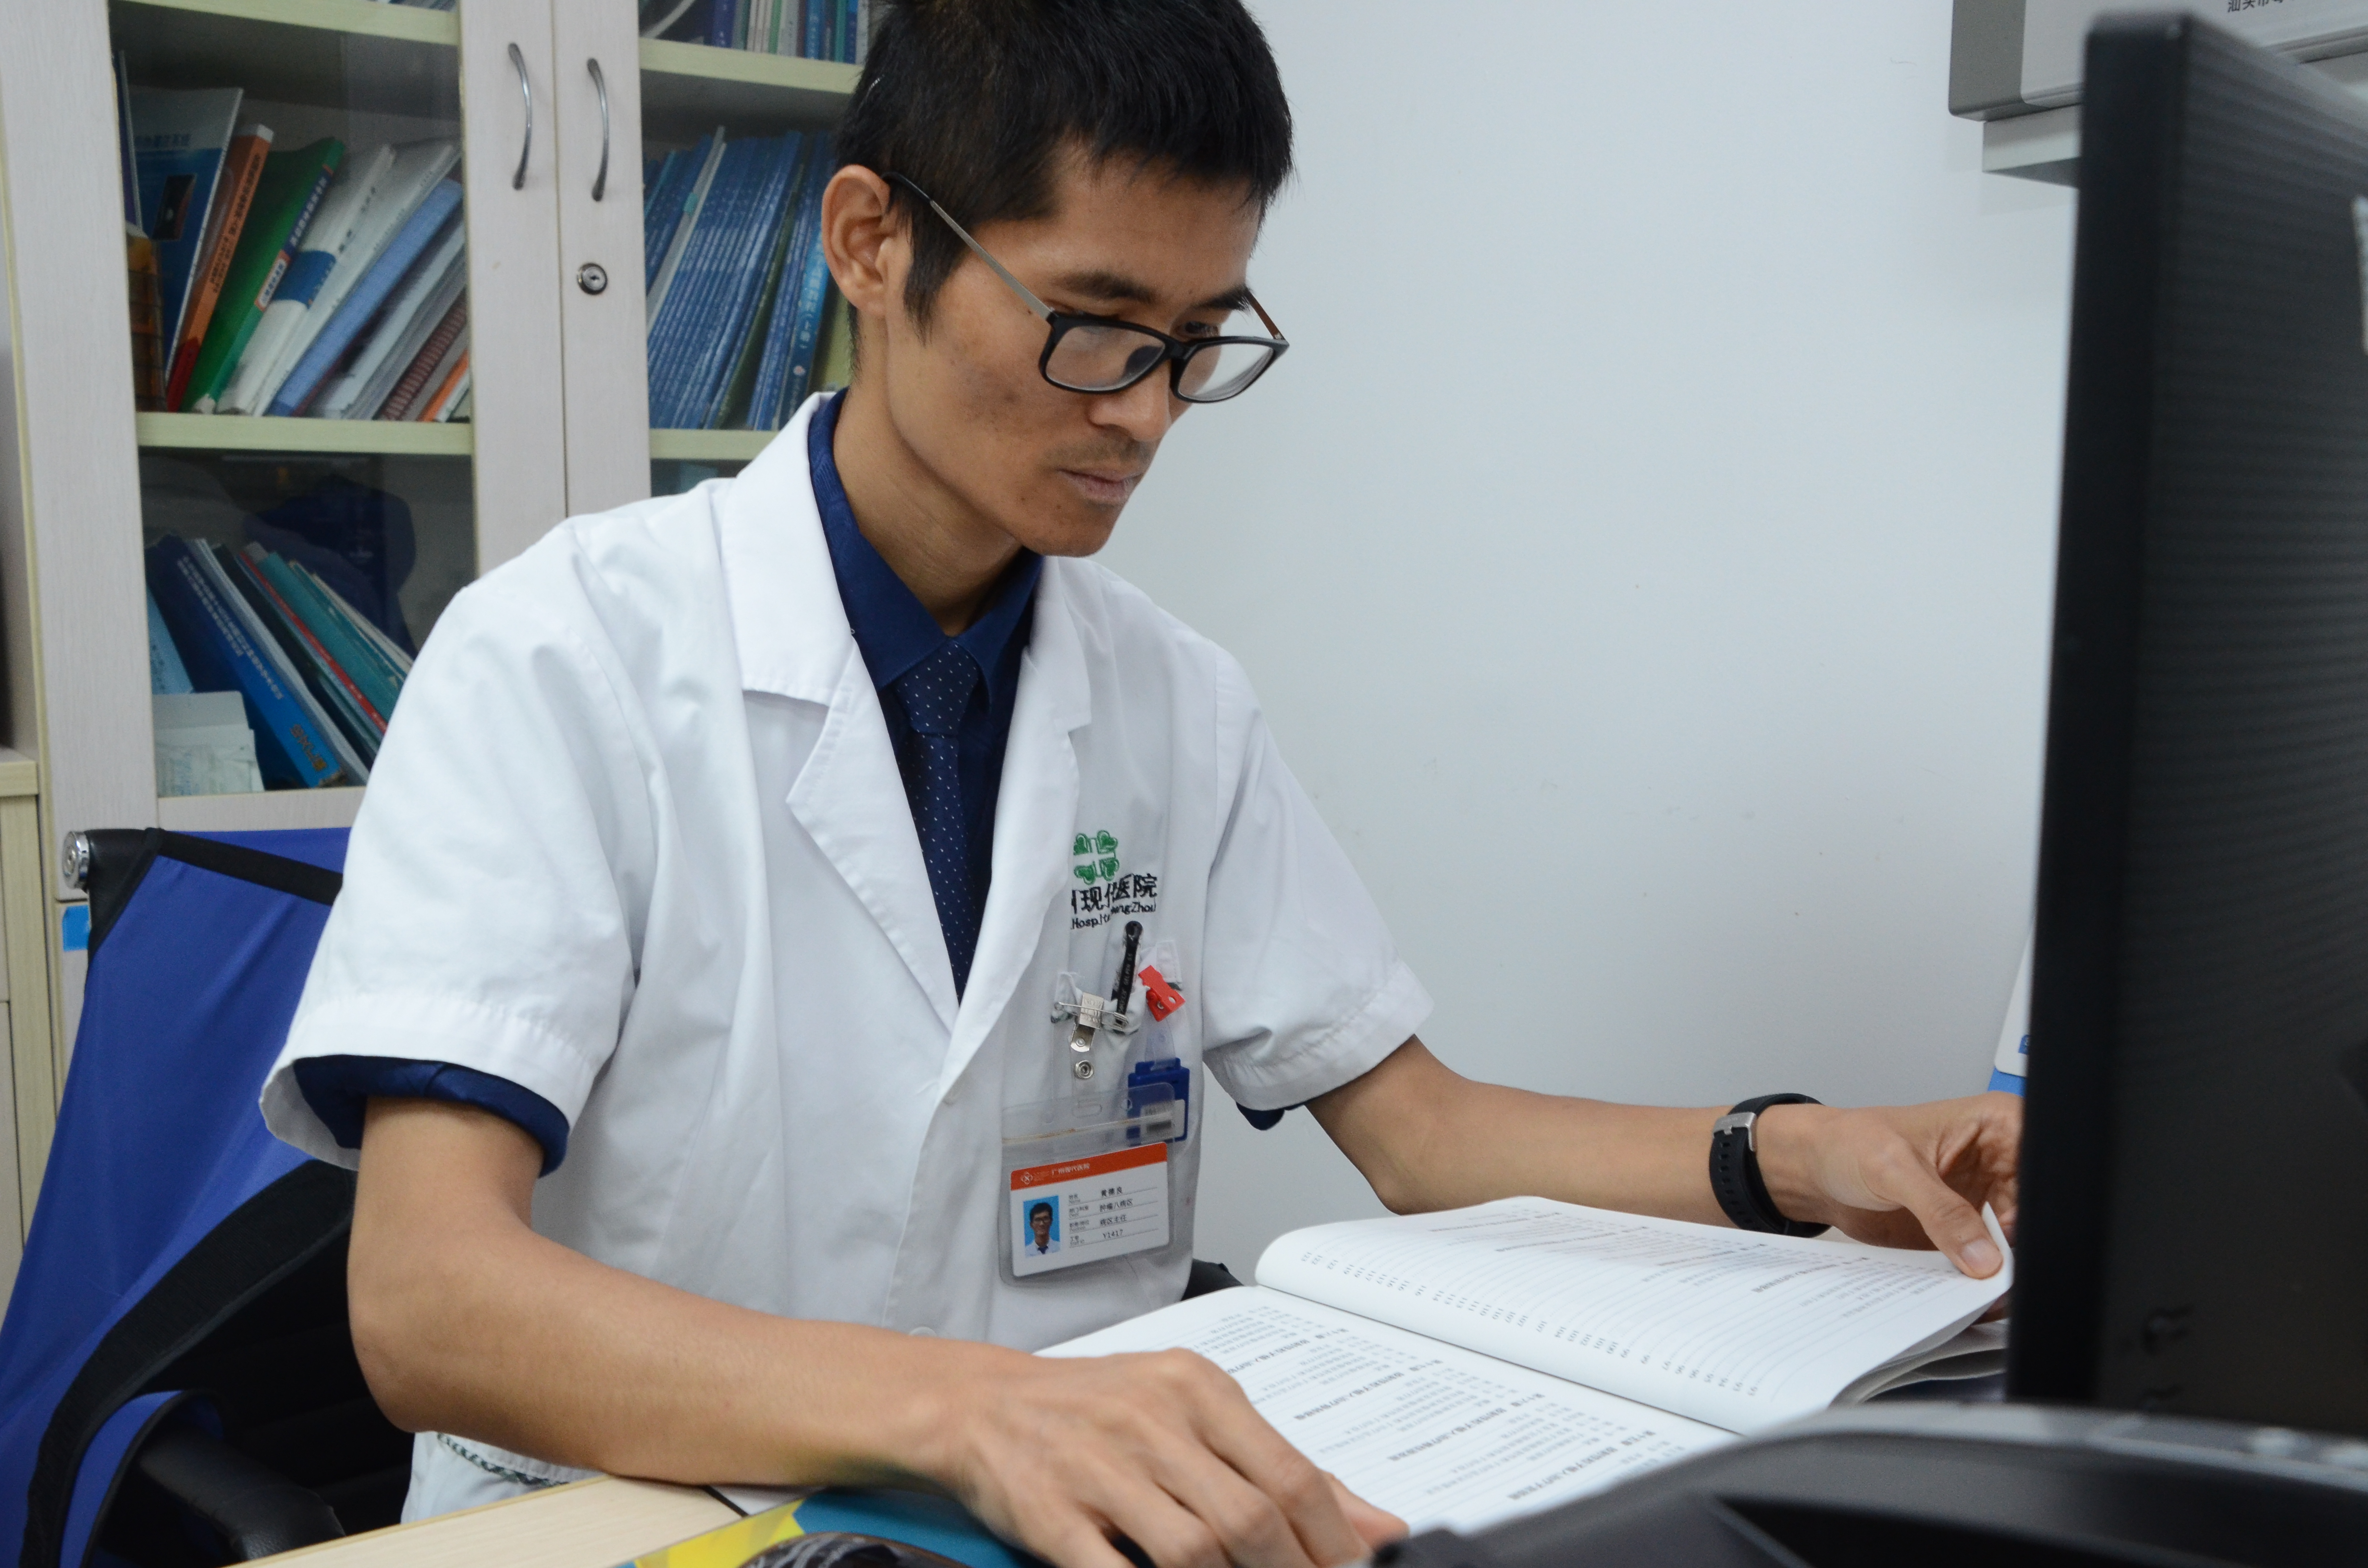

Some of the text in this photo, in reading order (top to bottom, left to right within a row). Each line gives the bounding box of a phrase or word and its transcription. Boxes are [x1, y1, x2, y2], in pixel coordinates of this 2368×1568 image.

[2227, 0, 2283, 12] 汕头市
[1051, 1163, 1091, 1176] 广州现代医院
[1099, 1199, 1133, 1212] 肿瘤八病区
[1099, 1214, 1127, 1226] 病区主任
[1103, 1229, 1123, 1239] Y1417
[1311, 1255, 1323, 1265] 122
[1327, 1260, 1338, 1270] 122
[1344, 1264, 1355, 1274] 119
[1354, 1267, 1365, 1278] 119
[1365, 1271, 1376, 1281] 117
[1376, 1274, 1387, 1285] 117
[1387, 1277, 1398, 1287] 116
[1398, 1281, 1409, 1291] 116
[1415, 1285, 1427, 1296] 116
[1432, 1290, 1444, 1301] 114
[1468, 1301, 1480, 1311] 111
[1480, 1304, 1492, 1316] 110
[1492, 1308, 1504, 1320] 110
[1505, 1311, 1516, 1323] 107
[1517, 1315, 1529, 1327] 107
[1536, 1321, 1547, 1333] 107
[1554, 1326, 1566, 1338] 104
[1567, 1330, 1579, 1342] 103
[1580, 1334, 1592, 1346] 102
[1593, 1337, 1606, 1349] 101
[1606, 1342, 1618, 1354] 100
[1662, 1361, 1671, 1371] 97
